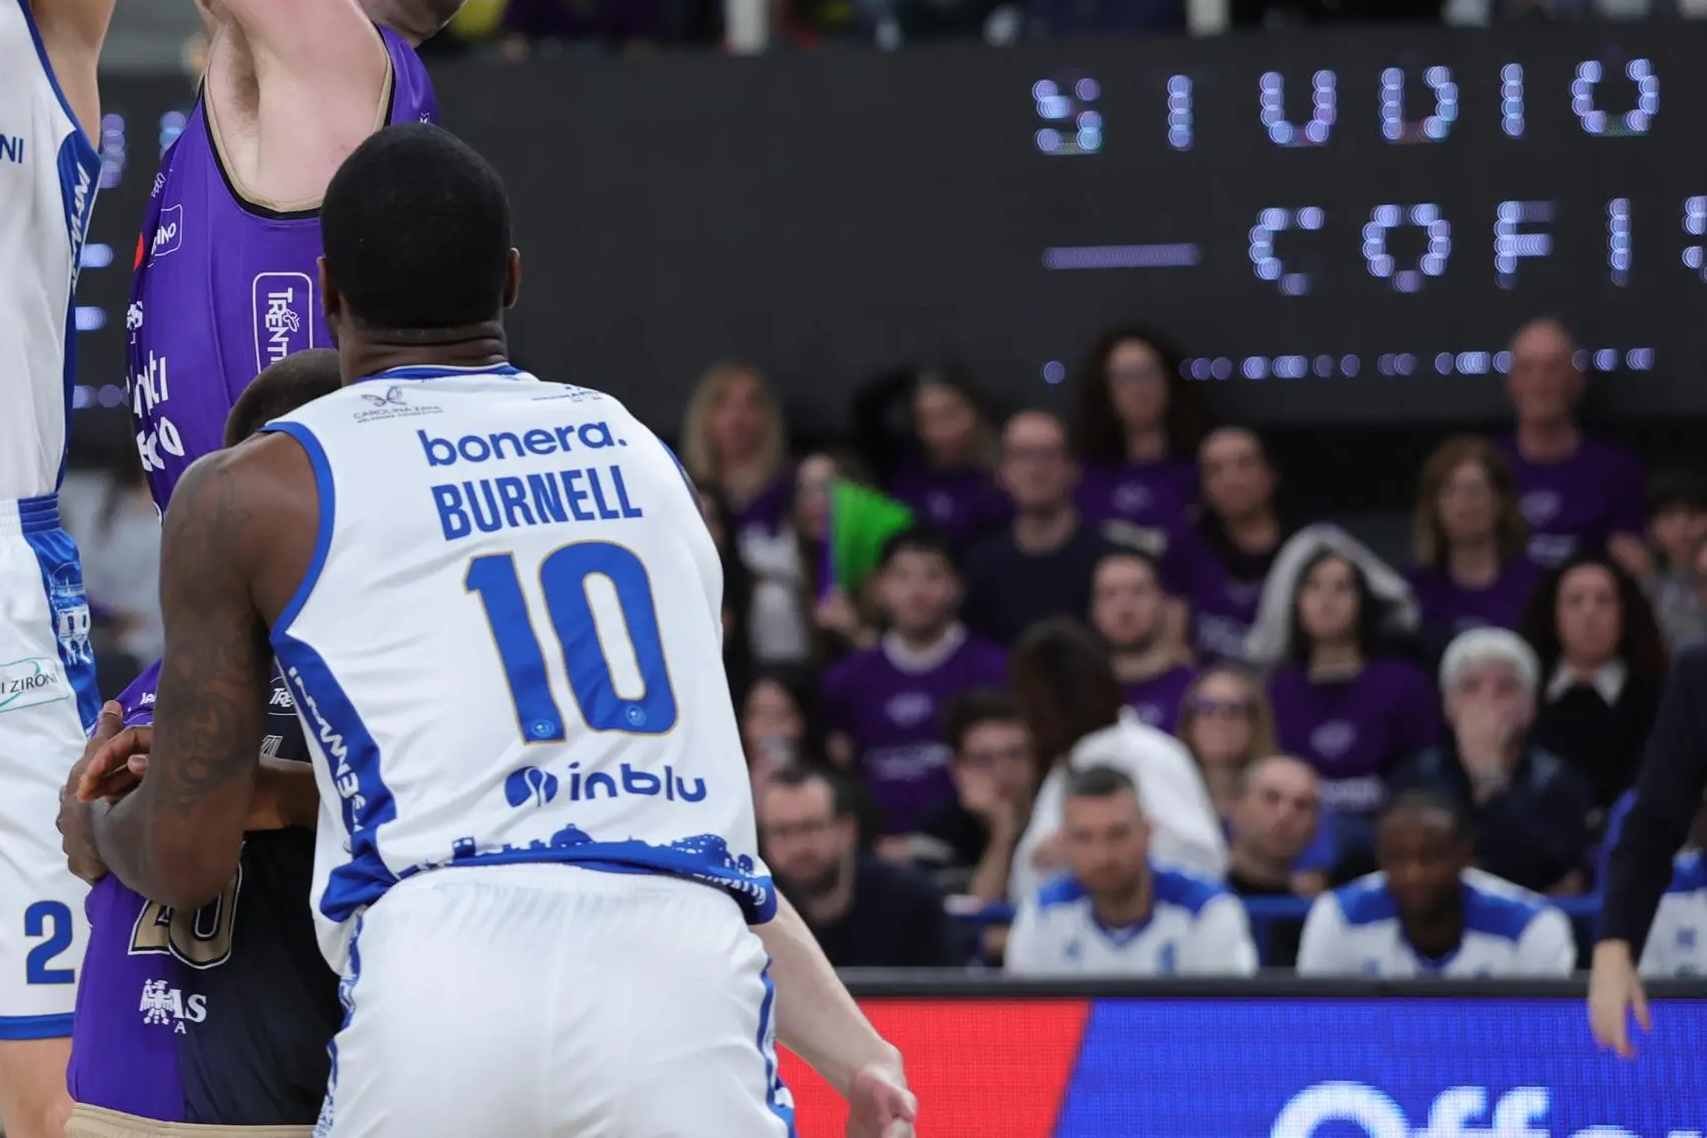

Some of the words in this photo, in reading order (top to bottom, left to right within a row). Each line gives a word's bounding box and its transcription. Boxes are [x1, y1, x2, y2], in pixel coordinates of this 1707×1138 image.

[417, 421, 628, 466] bonera.
[431, 465, 643, 541] BURNELL
[463, 539, 678, 746] 10
[568, 762, 707, 803] inblu
[24, 900, 75, 984] 2
